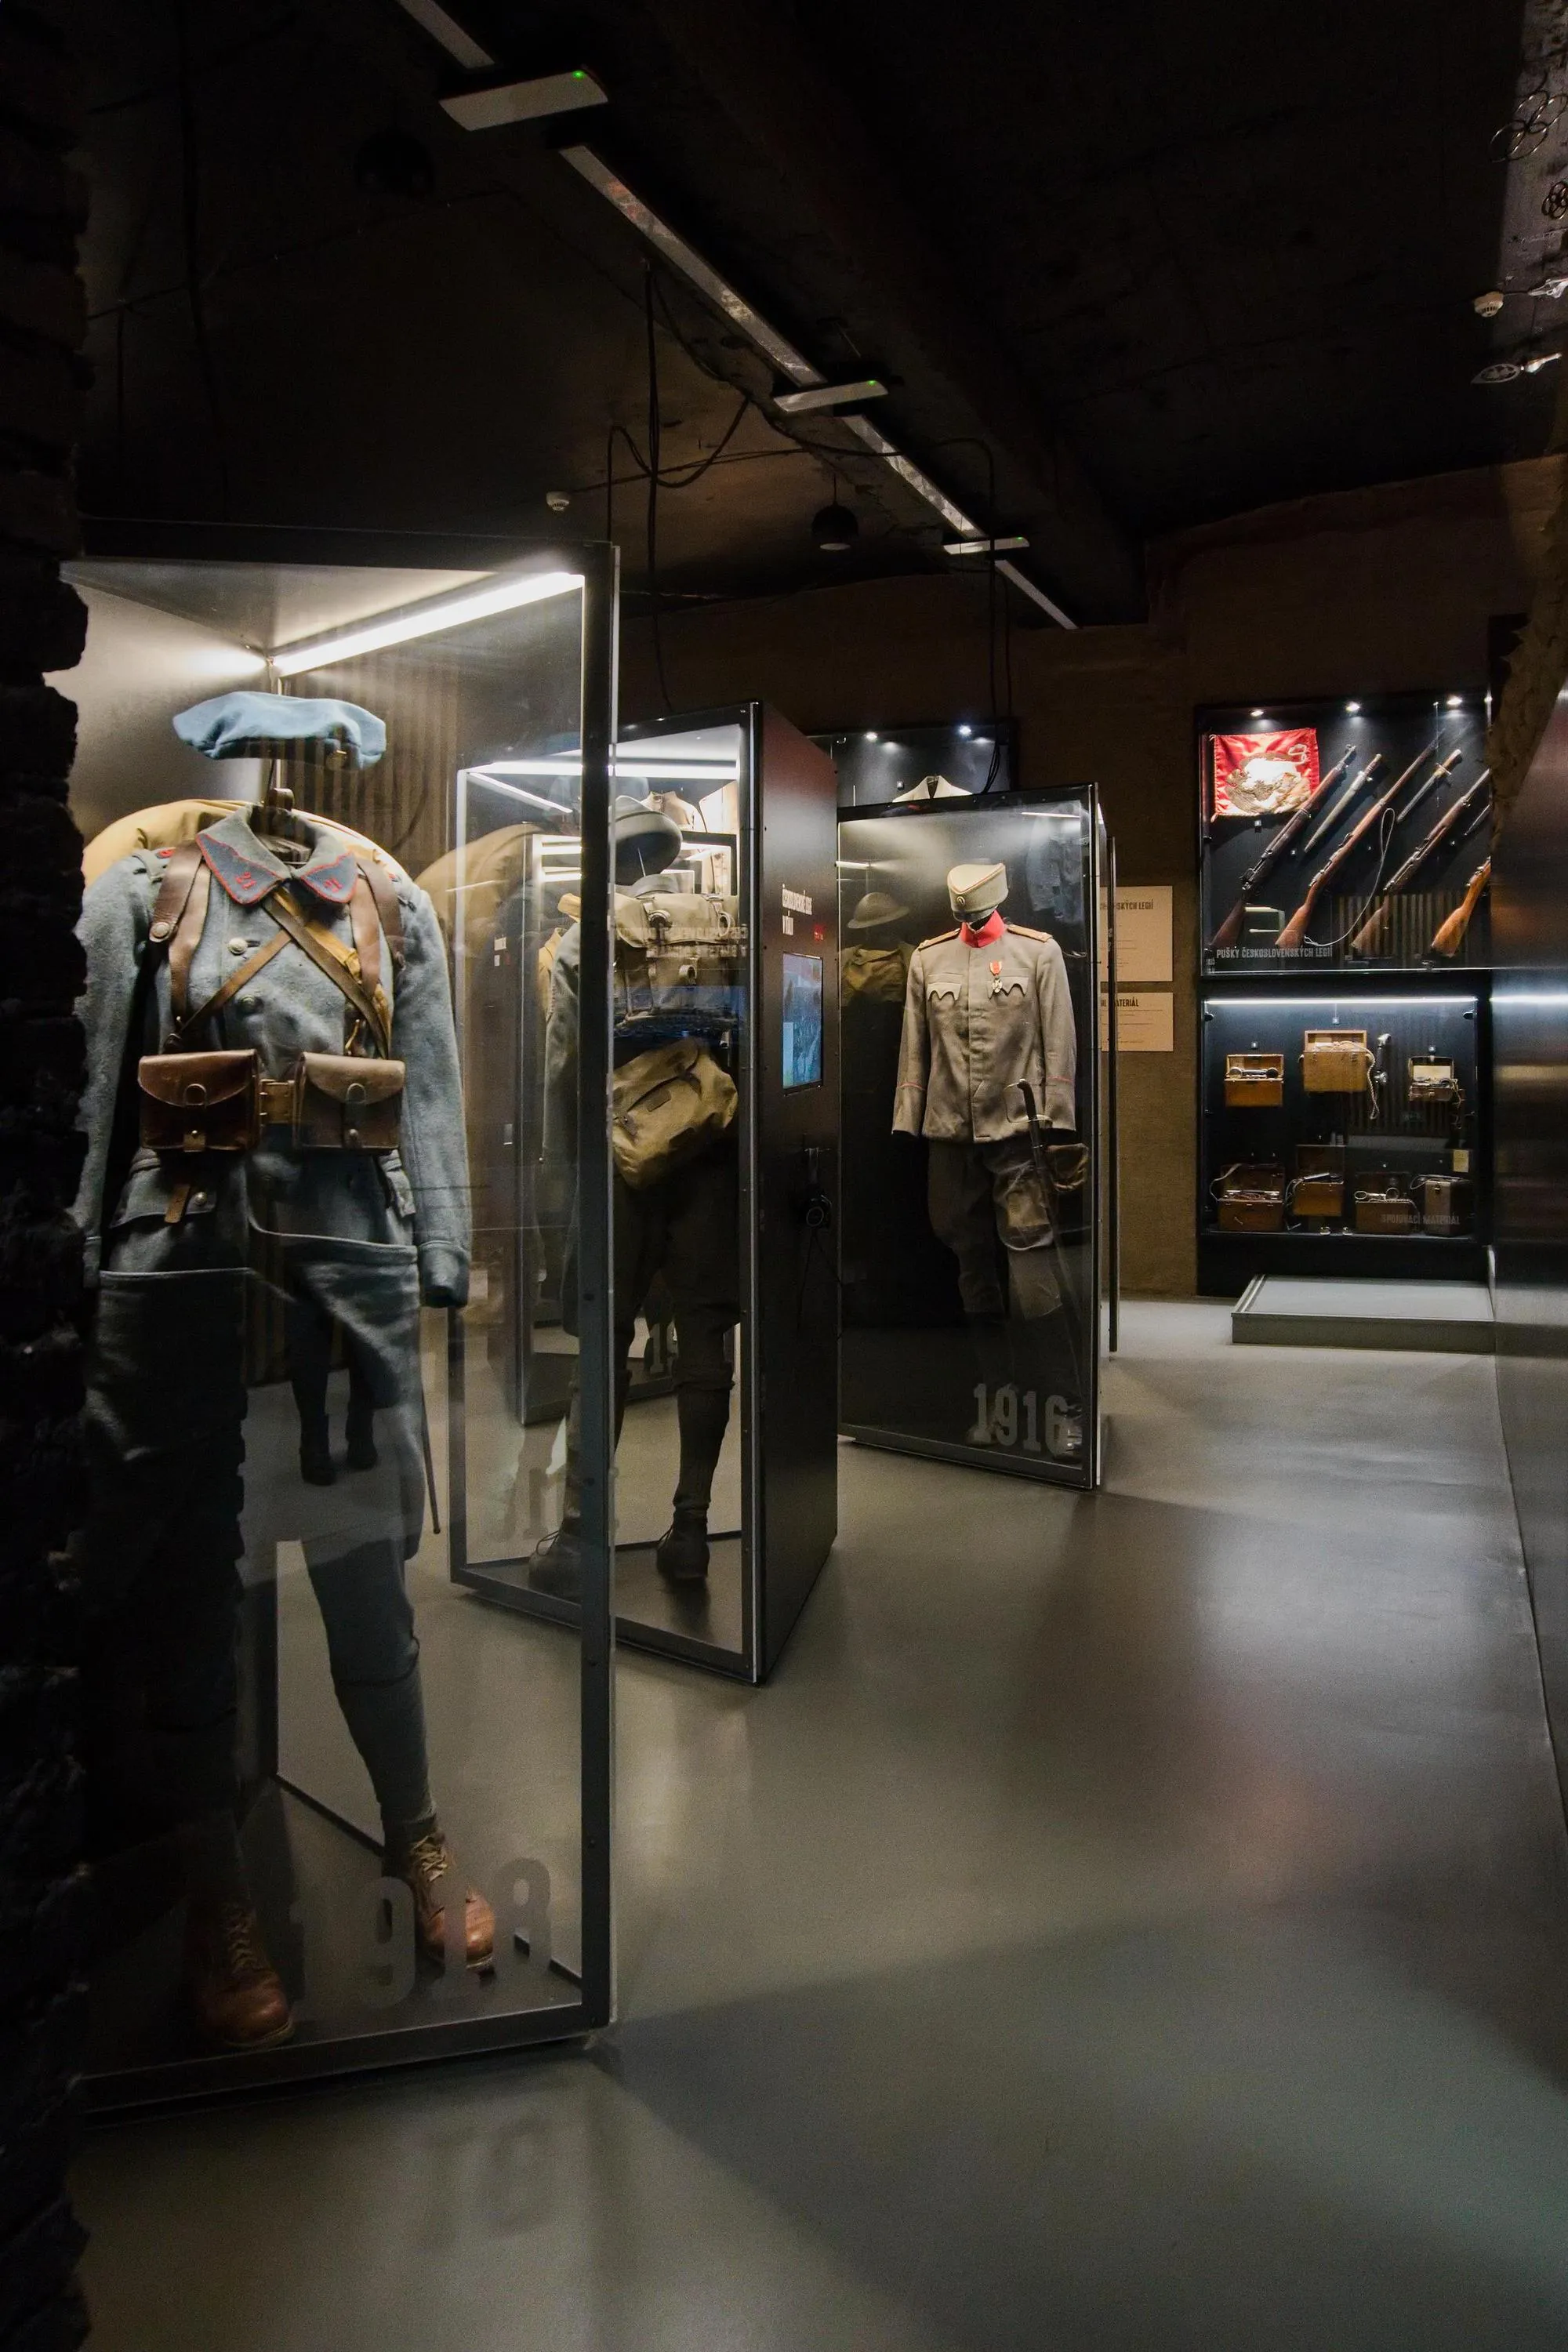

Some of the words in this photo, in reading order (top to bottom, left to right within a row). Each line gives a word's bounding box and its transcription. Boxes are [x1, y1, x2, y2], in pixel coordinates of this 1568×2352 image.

[1217, 946, 1240, 958] PUŠKY
[1242, 946, 1313, 958] ČESKOSLOVENSKÝCH
[974, 1383, 1069, 1454] 1916
